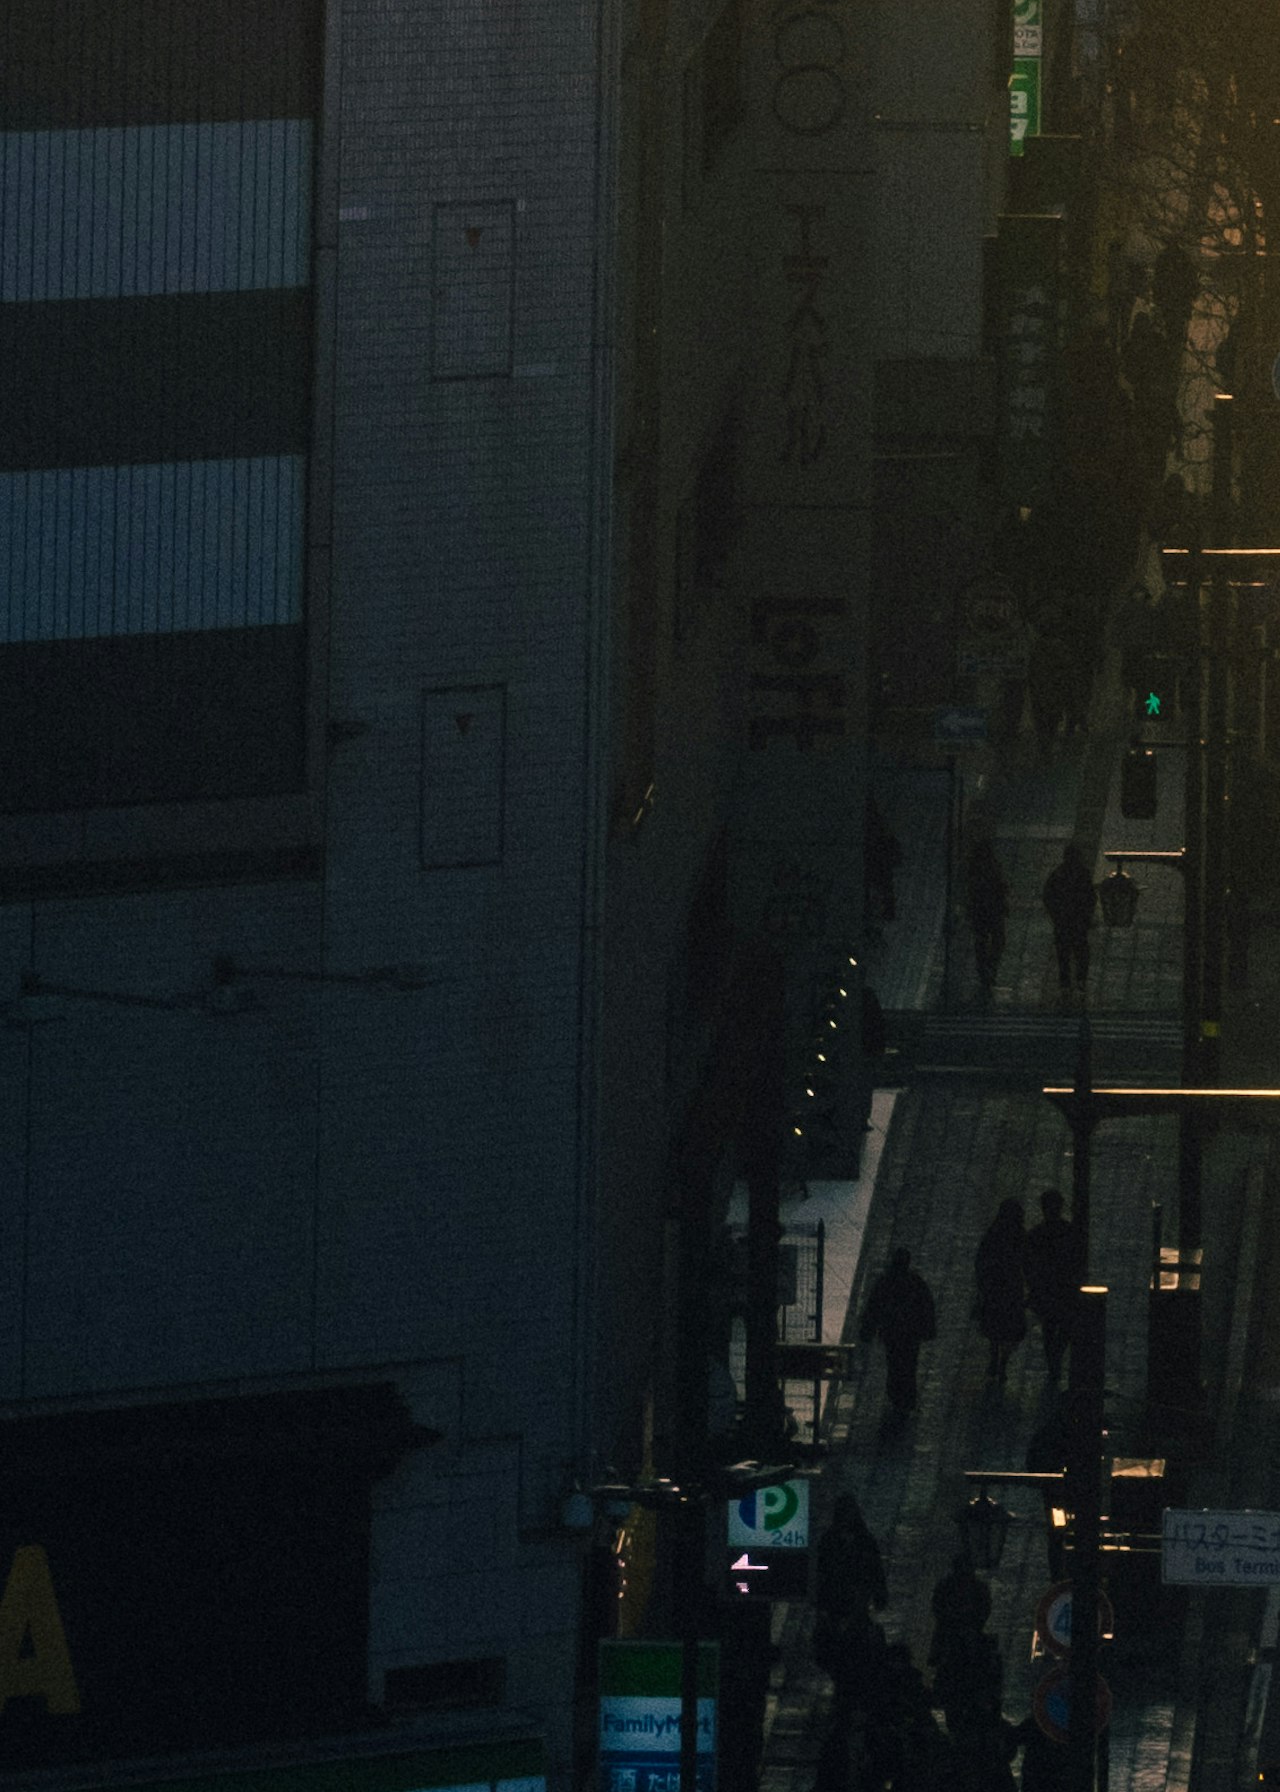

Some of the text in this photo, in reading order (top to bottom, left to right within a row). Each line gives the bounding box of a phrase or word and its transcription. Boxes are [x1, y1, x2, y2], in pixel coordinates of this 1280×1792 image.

[771, 1530, 806, 1546] 24h
[1195, 1557, 1225, 1575] Bus
[0, 1543, 82, 1714] A
[603, 1713, 711, 1738] FamilyMt
